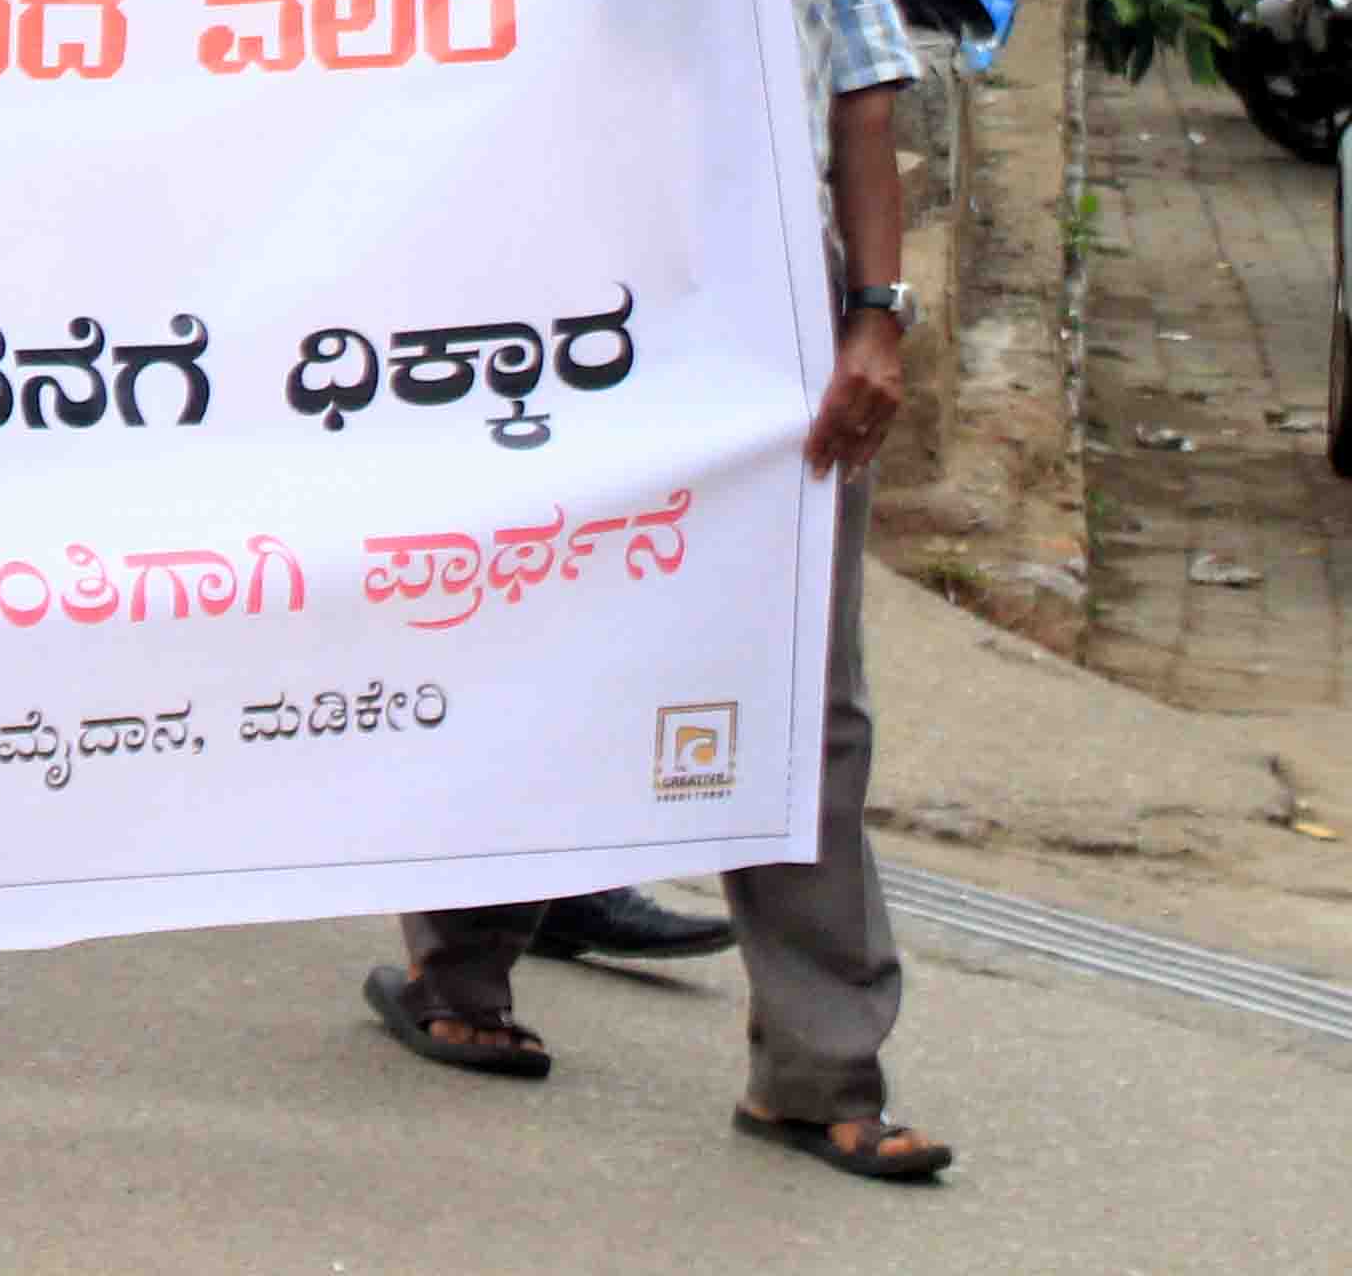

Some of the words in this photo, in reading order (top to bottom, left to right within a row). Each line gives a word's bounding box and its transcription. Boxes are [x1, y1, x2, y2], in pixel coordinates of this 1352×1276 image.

[285, 282, 635, 450] ಧಿಕ್ಕಾರ
[364, 487, 692, 629] ಪ್ರಾರ್ಥನೆ
[239, 679, 448, 743] ಮಡಿಕೇರಿ
